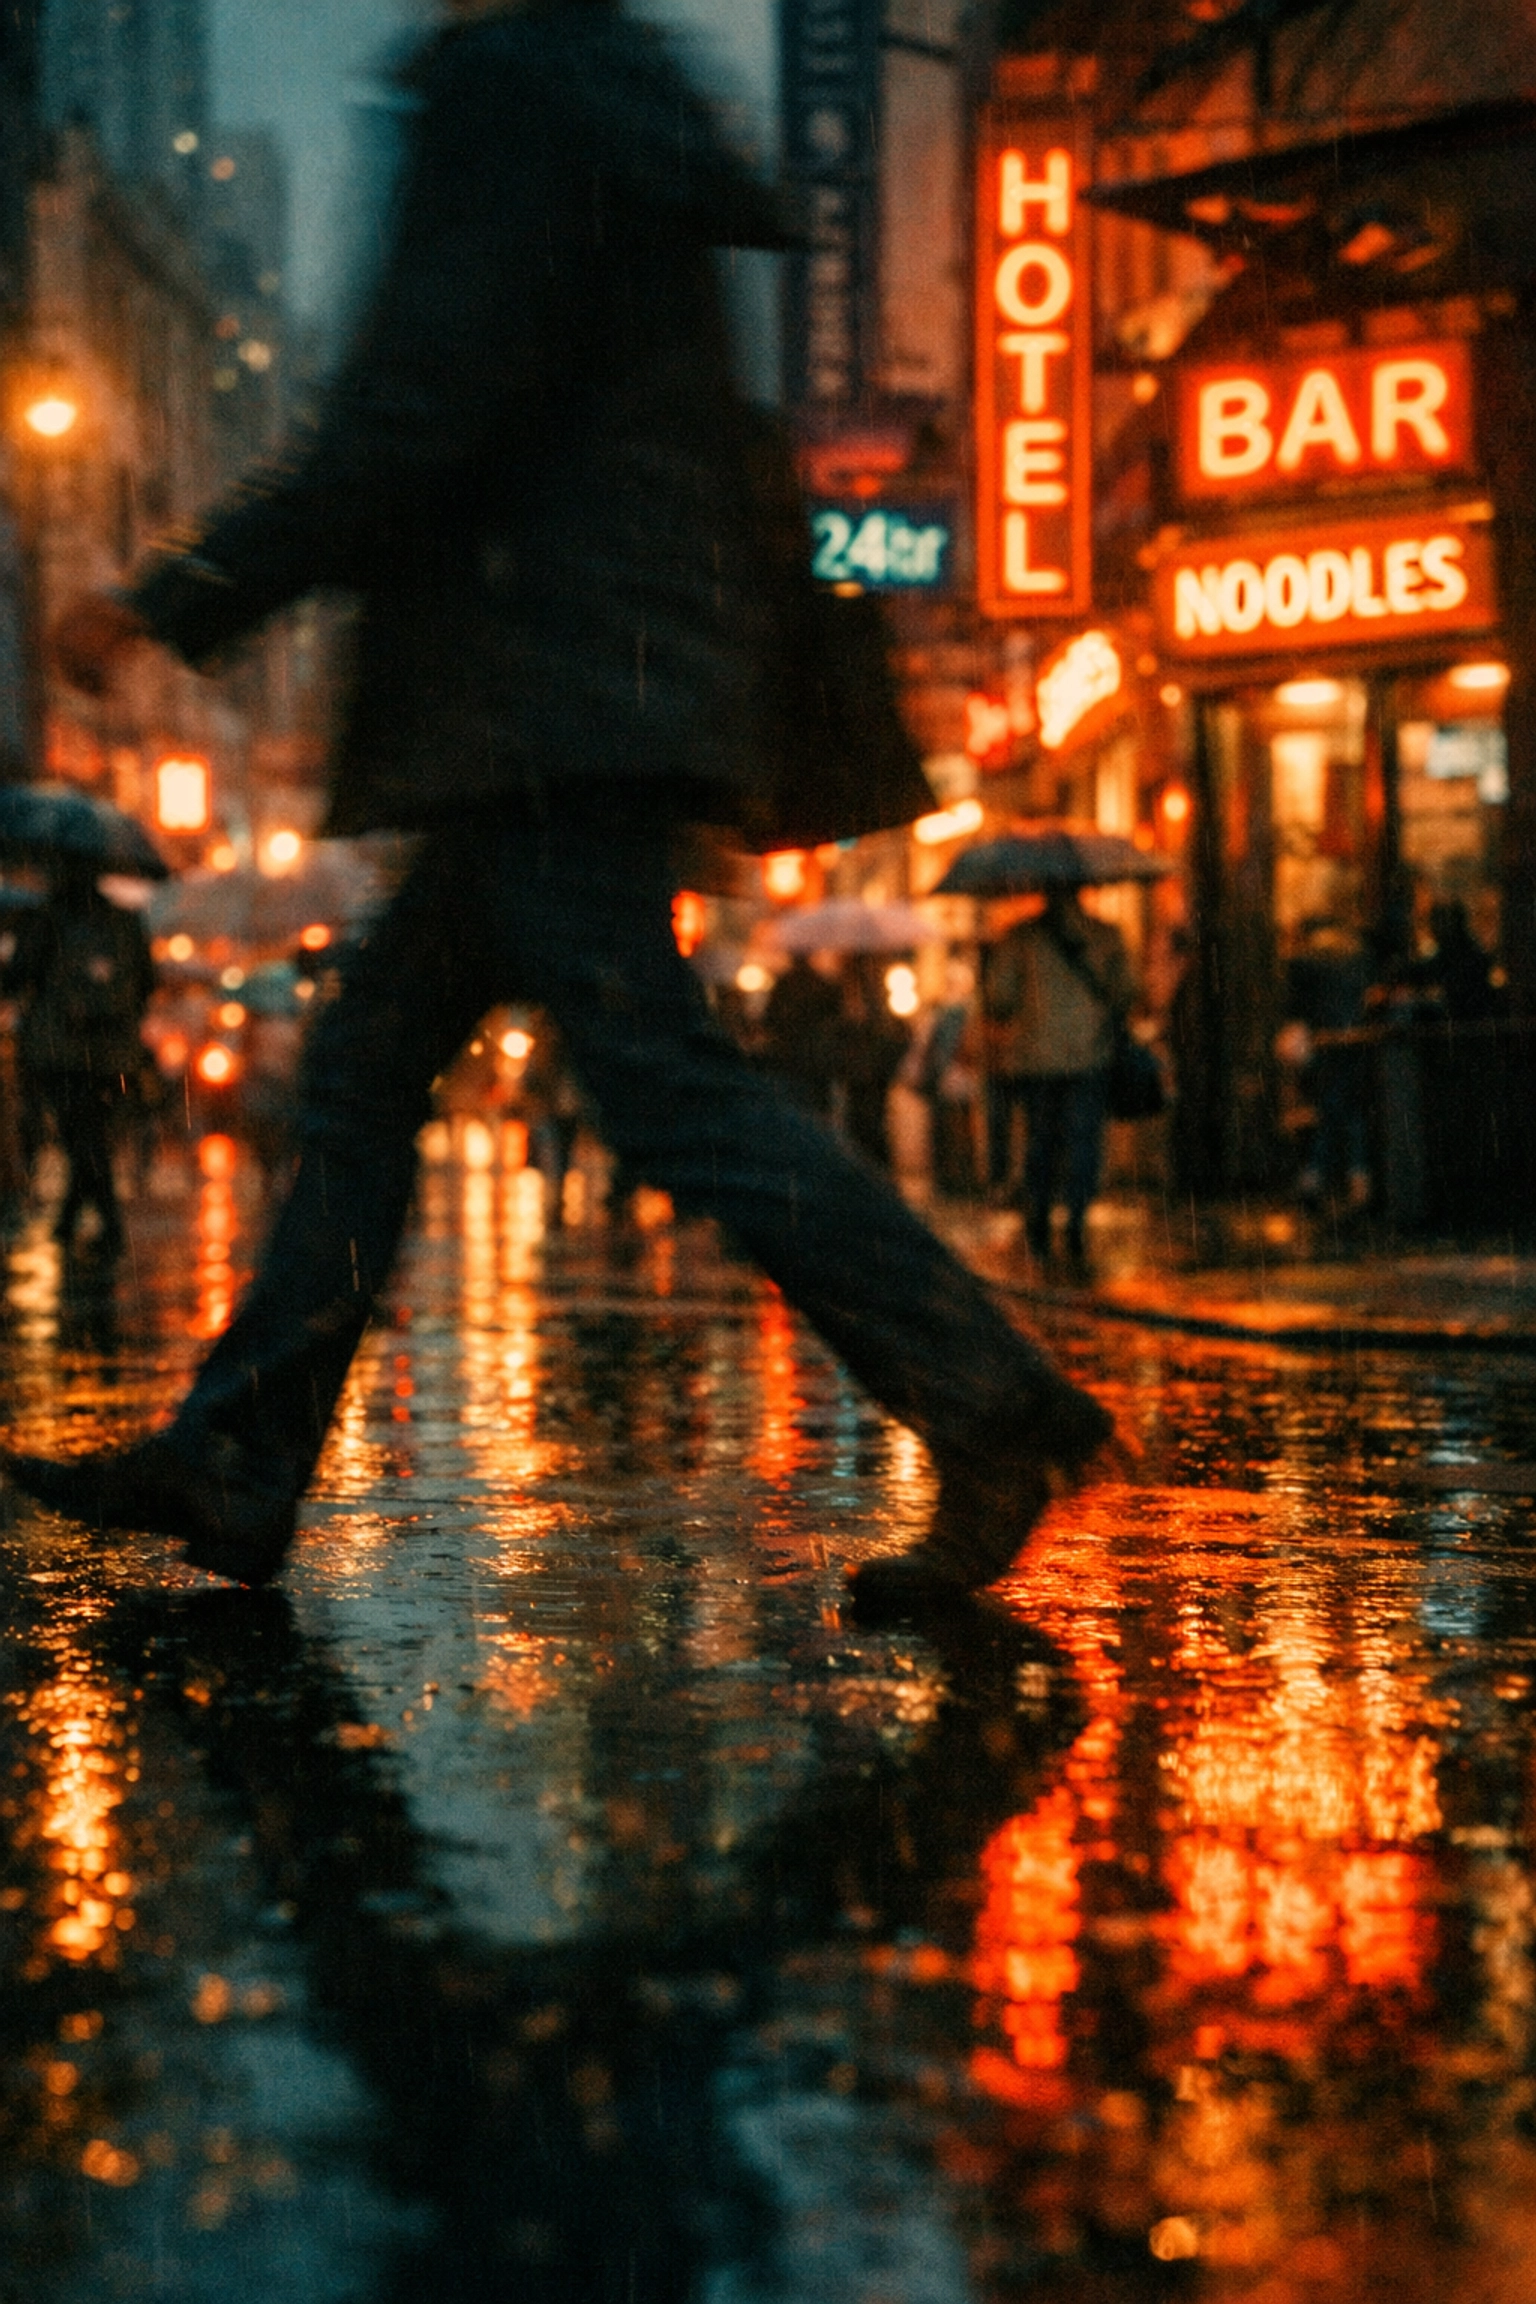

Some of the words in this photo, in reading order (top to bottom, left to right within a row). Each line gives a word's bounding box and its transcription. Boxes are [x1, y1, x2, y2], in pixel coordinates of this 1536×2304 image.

[997, 148, 1071, 592] HOTEL
[1199, 359, 1450, 480] BAR
[1174, 535, 1467, 640] NOODLES
